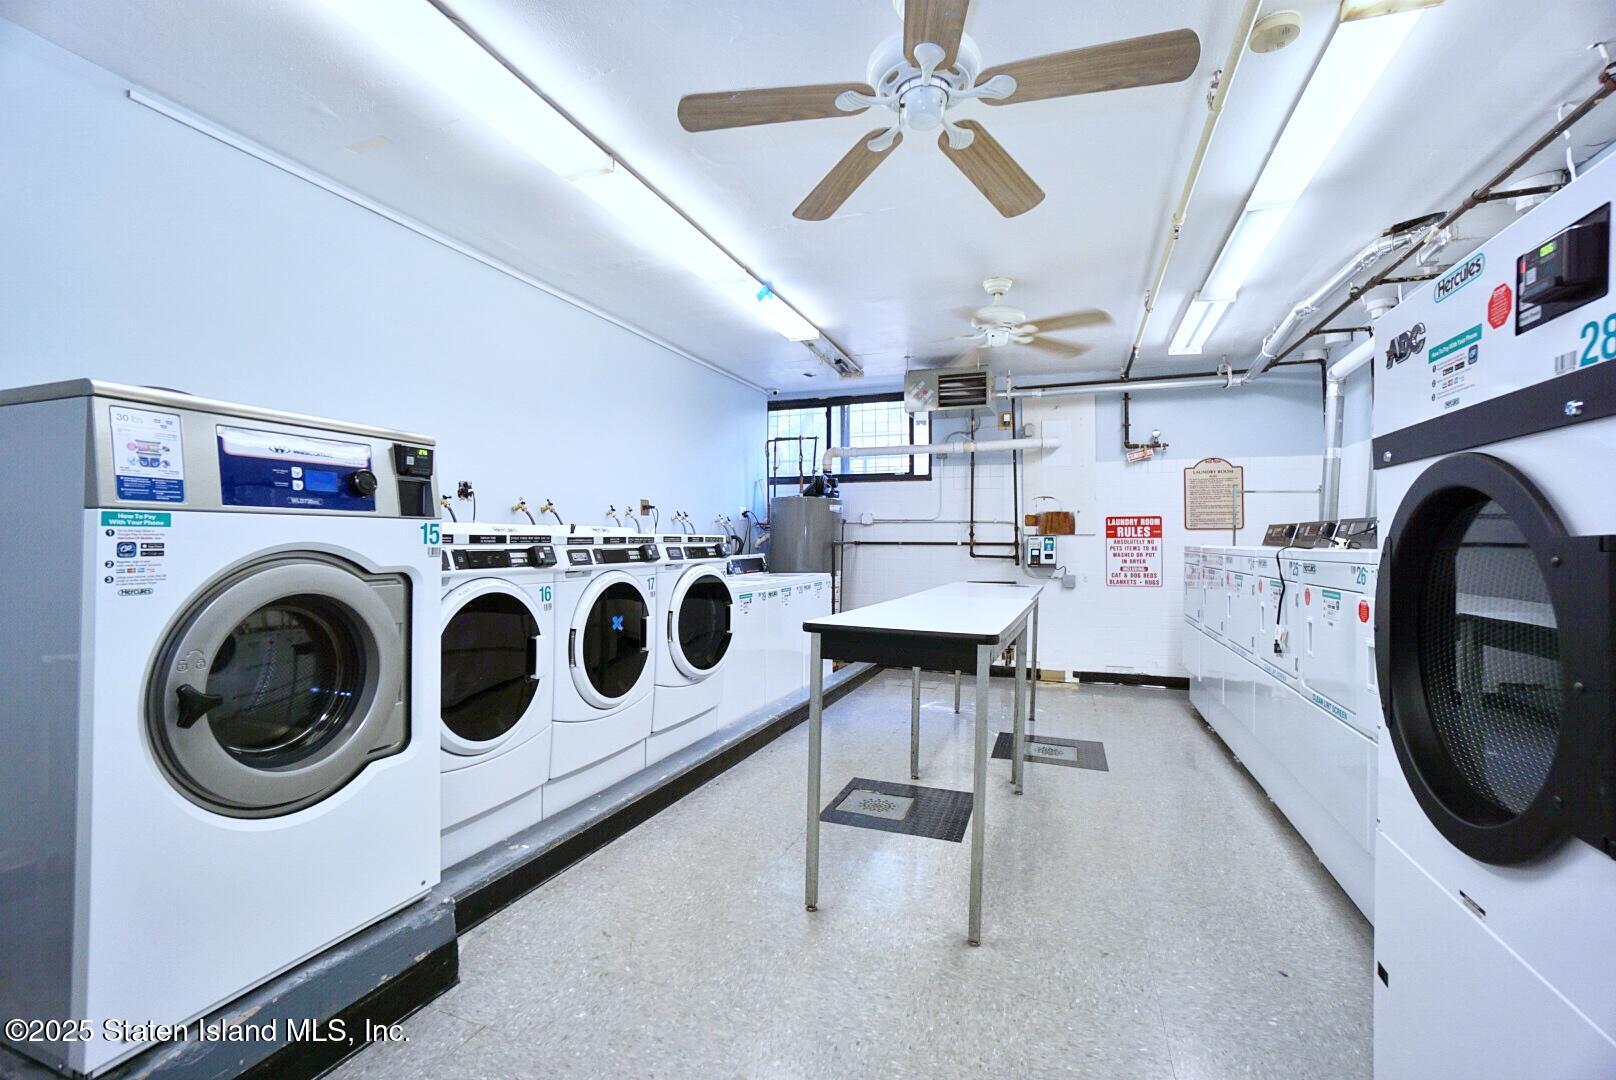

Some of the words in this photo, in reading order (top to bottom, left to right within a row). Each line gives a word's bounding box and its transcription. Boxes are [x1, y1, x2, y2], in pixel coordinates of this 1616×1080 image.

[1437, 258, 1481, 298] Hercules
[1580, 312, 1616, 368] 28
[116, 413, 129, 421] 30
[1108, 518, 1138, 526] LAUNDRY
[420, 523, 440, 545] 15
[1117, 526, 1151, 537] RULES
[1292, 562, 1299, 576] 25
[1356, 566, 1366, 585] 26
[647, 577, 655, 590] 17
[121, 588, 151, 596] Hercules
[539, 585, 551, 602] 16
[1312, 693, 1323, 706] CLEAN
[1324, 700, 1332, 709] LINT
[1332, 704, 1348, 720] SCREEN
